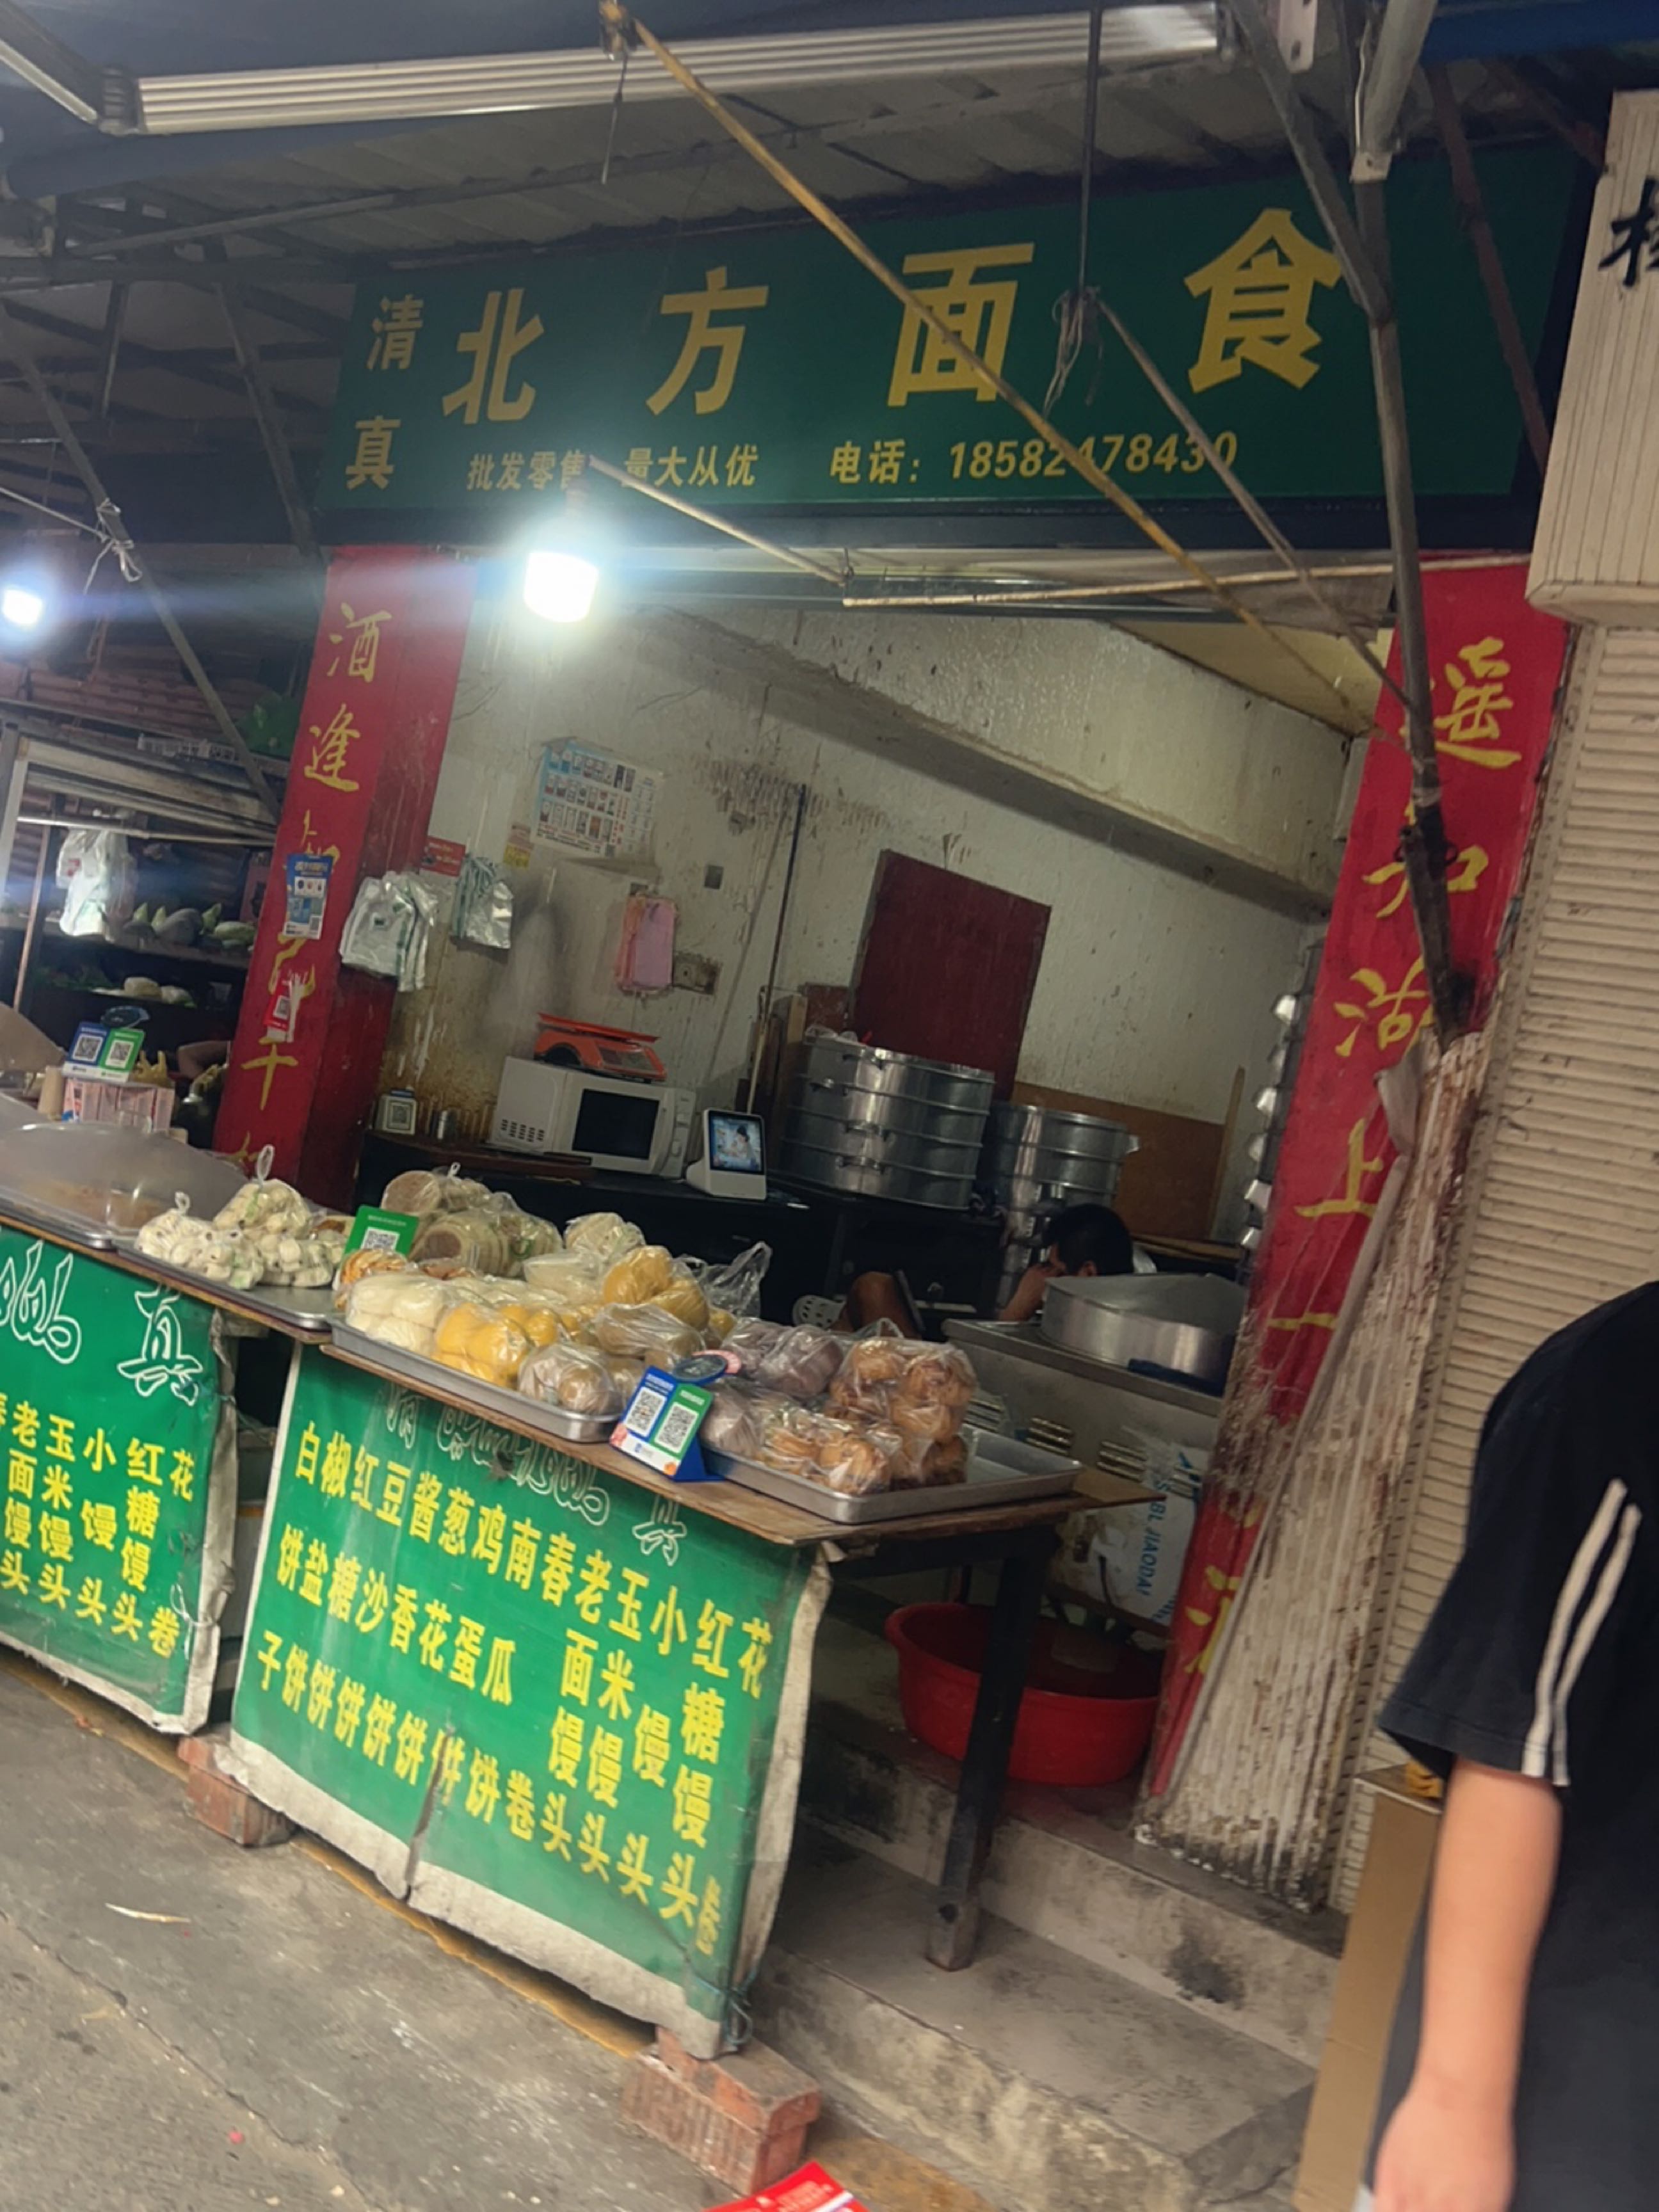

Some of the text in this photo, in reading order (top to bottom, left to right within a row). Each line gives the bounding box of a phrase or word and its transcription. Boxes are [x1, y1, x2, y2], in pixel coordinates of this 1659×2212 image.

[346, 294, 424, 490] 清真
[442, 208, 1342, 424] 北方面食
[467, 444, 759, 491] 批发零售 量大从优
[1, 1400, 40, 1595] 老面馒头
[38, 1415, 76, 1609] 玉米馒头
[76, 1428, 117, 1625] 小馒头
[111, 1438, 165, 1641] 红糖馒头
[148, 1448, 195, 1658] 花卷
[258, 1421, 321, 1690] 白饼子
[281, 1431, 346, 1713] 椒盐饼
[306, 1446, 380, 1729] 红糖饼
[337, 1461, 410, 1747] 豆沙饼
[363, 1471, 442, 1766] 酱香饼
[395, 1487, 474, 1786] 葱花饼
[430, 1504, 505, 1806] 鸡蛋饼
[465, 1518, 541, 1824] 南瓜饼
[506, 1533, 575, 1841] 春卷
[541, 1550, 611, 1861] 老面馒头
[578, 1567, 650, 1884] 玉米馒头
[617, 1585, 687, 1905] 小馒头
[660, 1600, 733, 1928] 红糖馒头
[696, 1616, 773, 1955] 花卷
